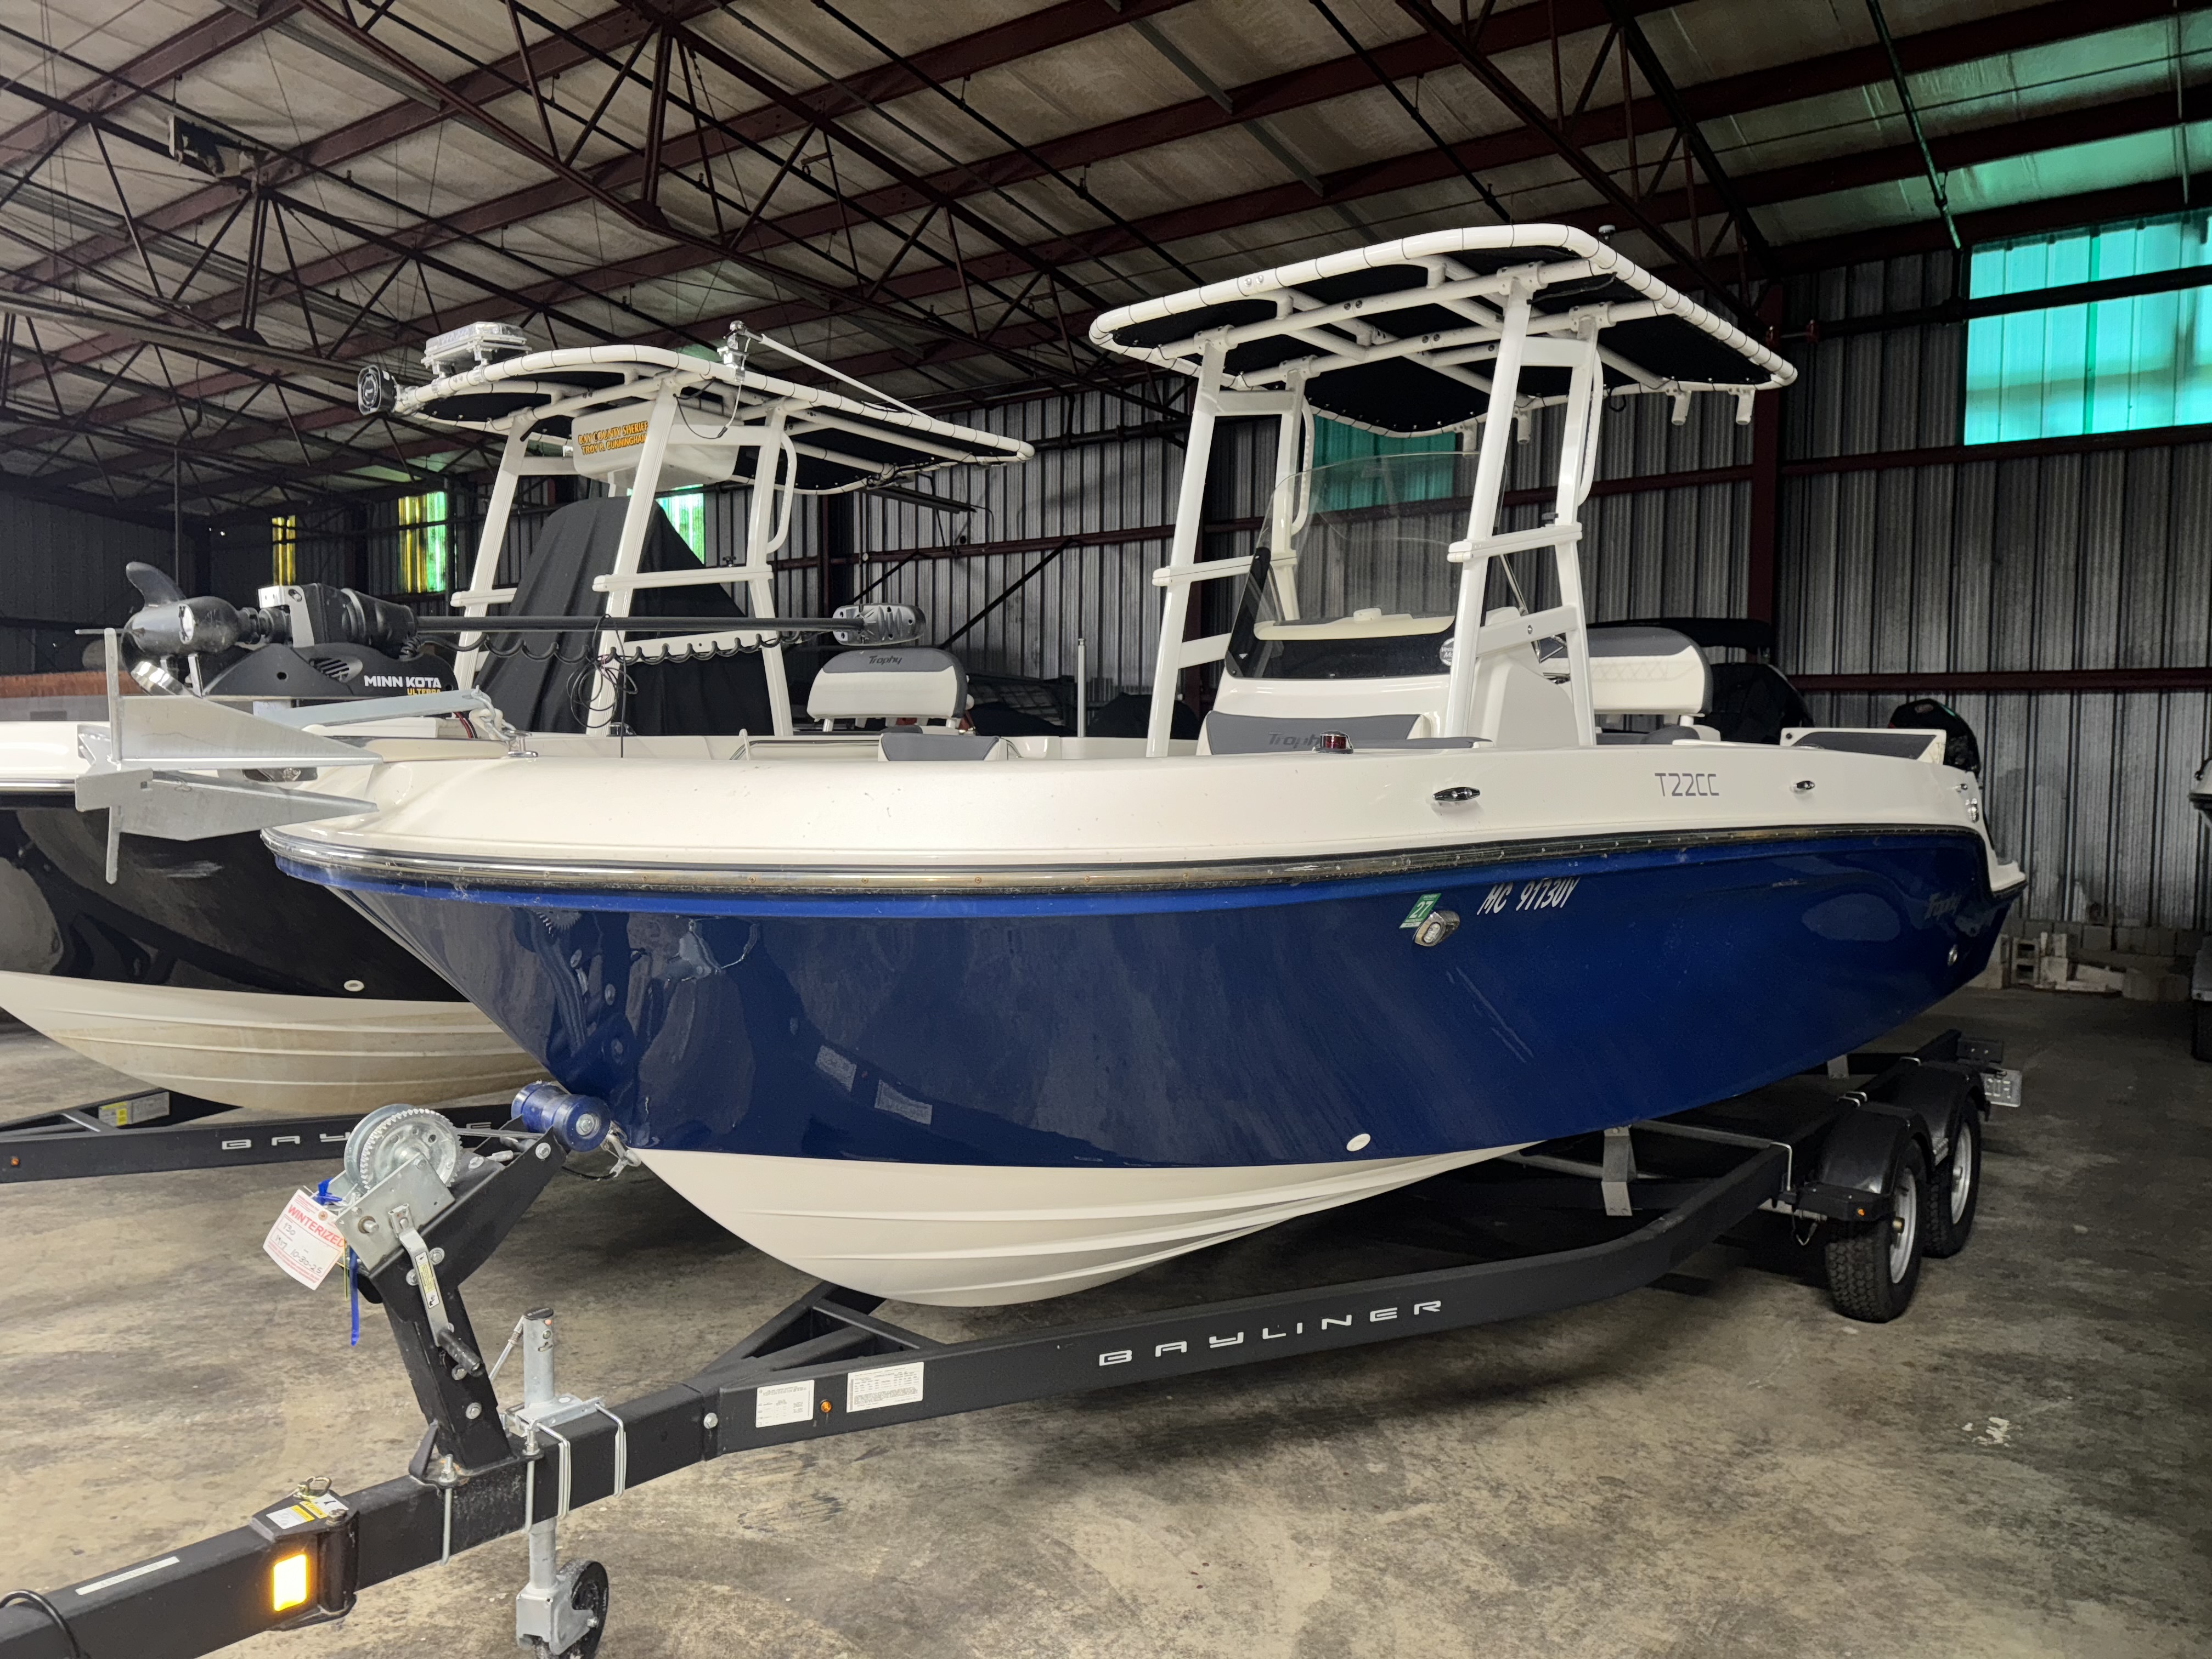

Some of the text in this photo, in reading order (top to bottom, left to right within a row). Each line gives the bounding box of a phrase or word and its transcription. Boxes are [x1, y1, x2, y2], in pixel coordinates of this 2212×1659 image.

[578, 420, 648, 445] BAY COUNTY SHERIFF
[582, 433, 647, 455] TROY R. CUNNINGHAM
[869, 656, 902, 665] Trophy
[364, 675, 442, 689] MINN KOTA
[1268, 731, 1321, 749] Troph
[1655, 773, 1719, 797] T22CC
[1408, 901, 1434, 918] 27
[1476, 881, 1514, 915] MC
[288, 1204, 346, 1248] WINTERIZED
[1099, 1301, 1441, 1367] BAYLINER
